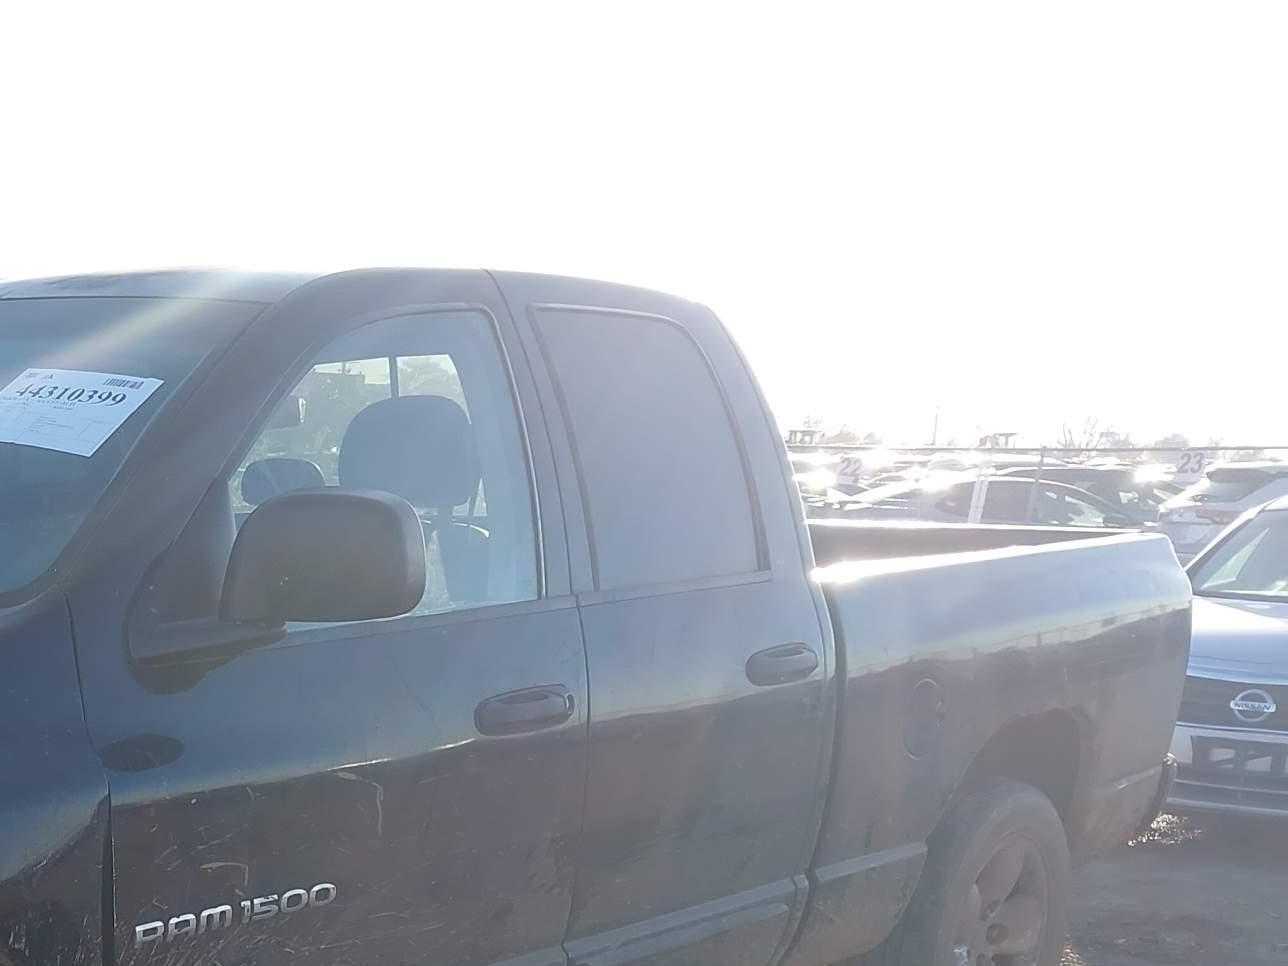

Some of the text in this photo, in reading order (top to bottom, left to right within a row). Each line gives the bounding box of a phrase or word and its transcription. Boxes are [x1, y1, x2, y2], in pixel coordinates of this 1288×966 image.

[15, 383, 127, 407] 44310399
[1177, 452, 1204, 474] 23
[1233, 702, 1273, 712] NISSAN
[134, 882, 337, 949] RAM 1500
